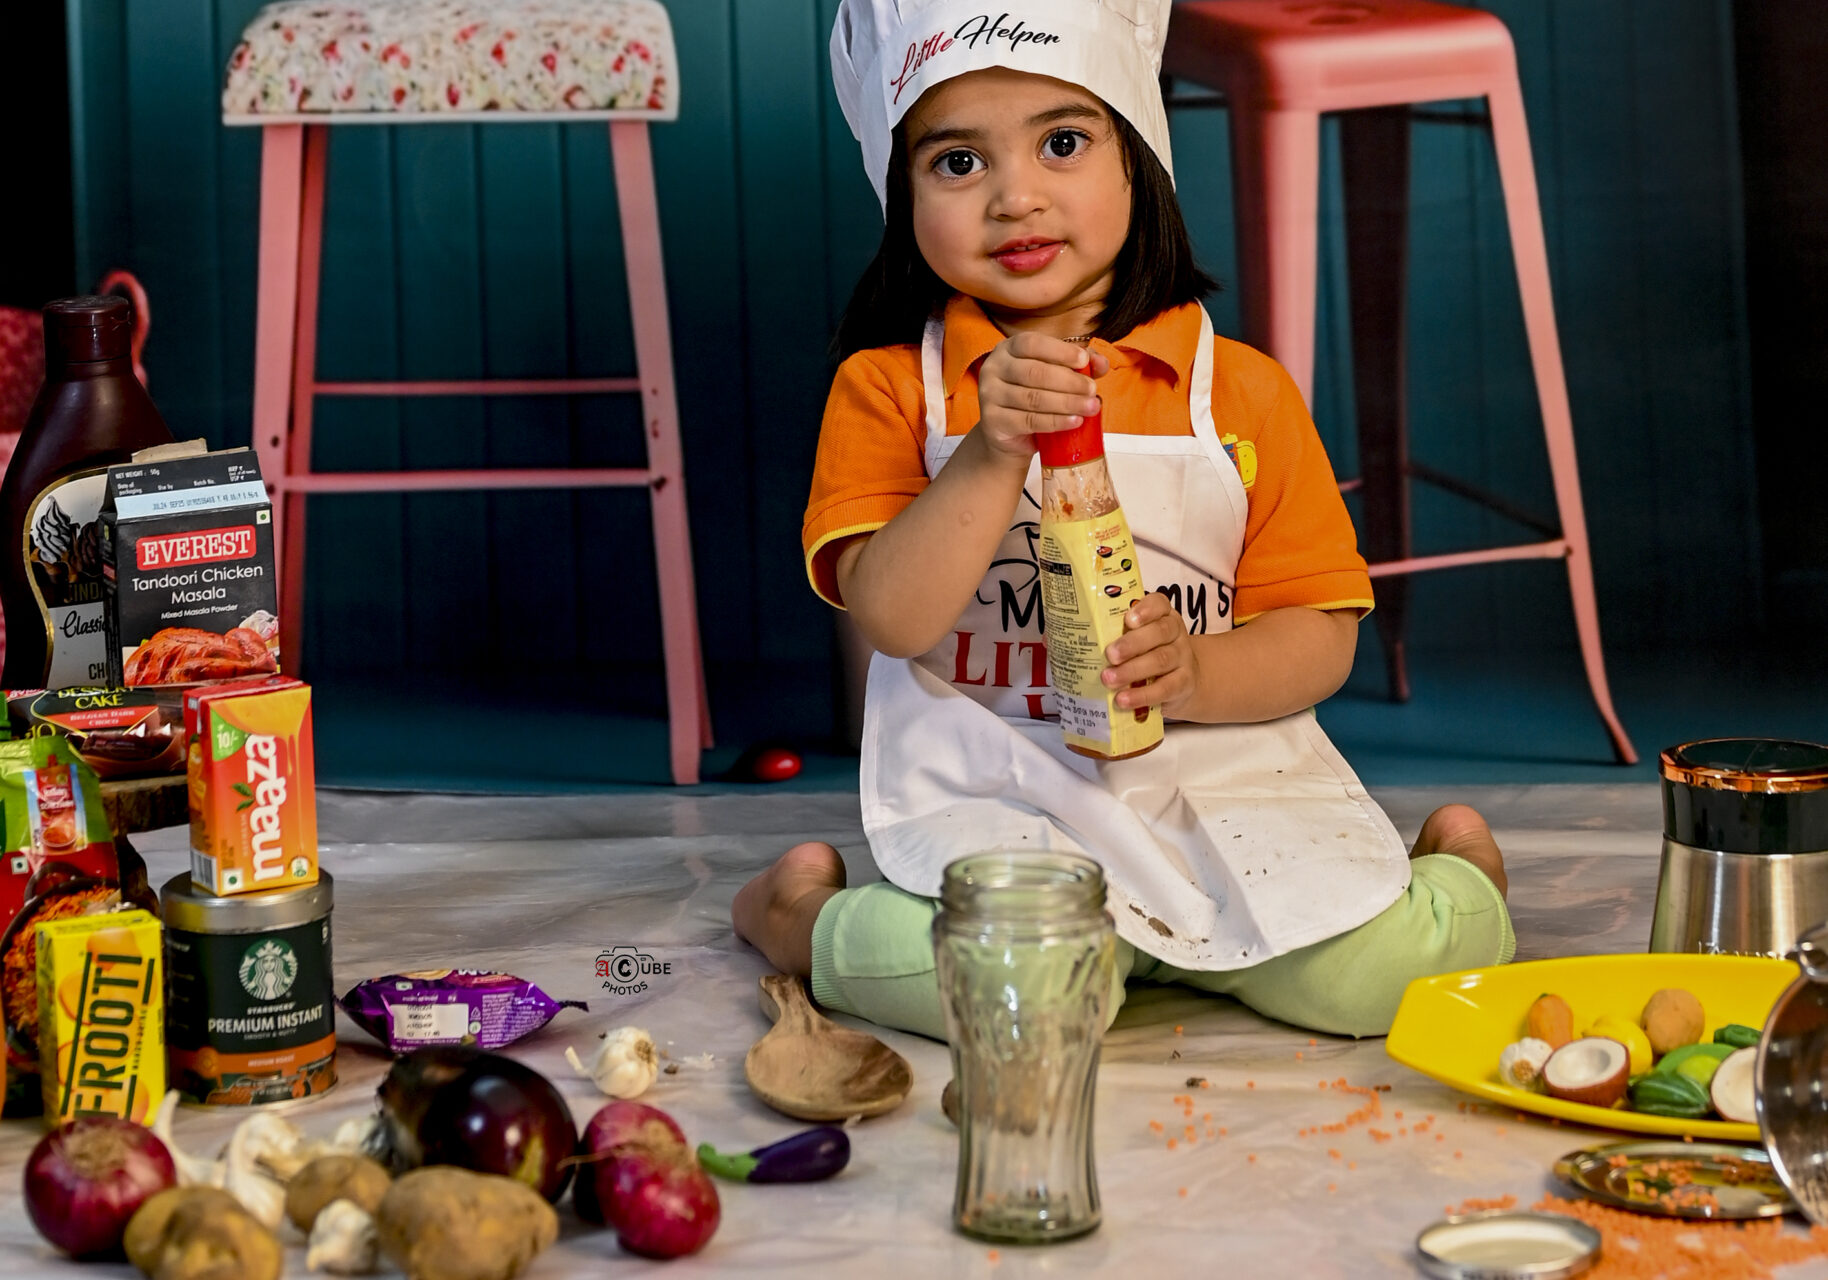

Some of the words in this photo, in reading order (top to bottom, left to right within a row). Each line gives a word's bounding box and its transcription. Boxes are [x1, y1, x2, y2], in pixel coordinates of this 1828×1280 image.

[891, 31, 953, 104] Little
[954, 13, 1060, 52] Helper
[142, 530, 250, 566] EVEREST
[132, 570, 198, 591] Tandoori
[202, 565, 263, 582] Chicken
[171, 586, 226, 605] Masala
[161, 610, 183, 620] Mixed
[184, 607, 210, 618] Masala
[211, 603, 238, 613] Powder
[75, 694, 124, 709] CAKE
[245, 734, 287, 881] maaza
[208, 1016, 274, 1033] PREMIUM
[277, 1003, 323, 1029] INSTANT
[247, 1001, 296, 1015] STARBUCKS
[73, 954, 142, 1120] FROOTI
